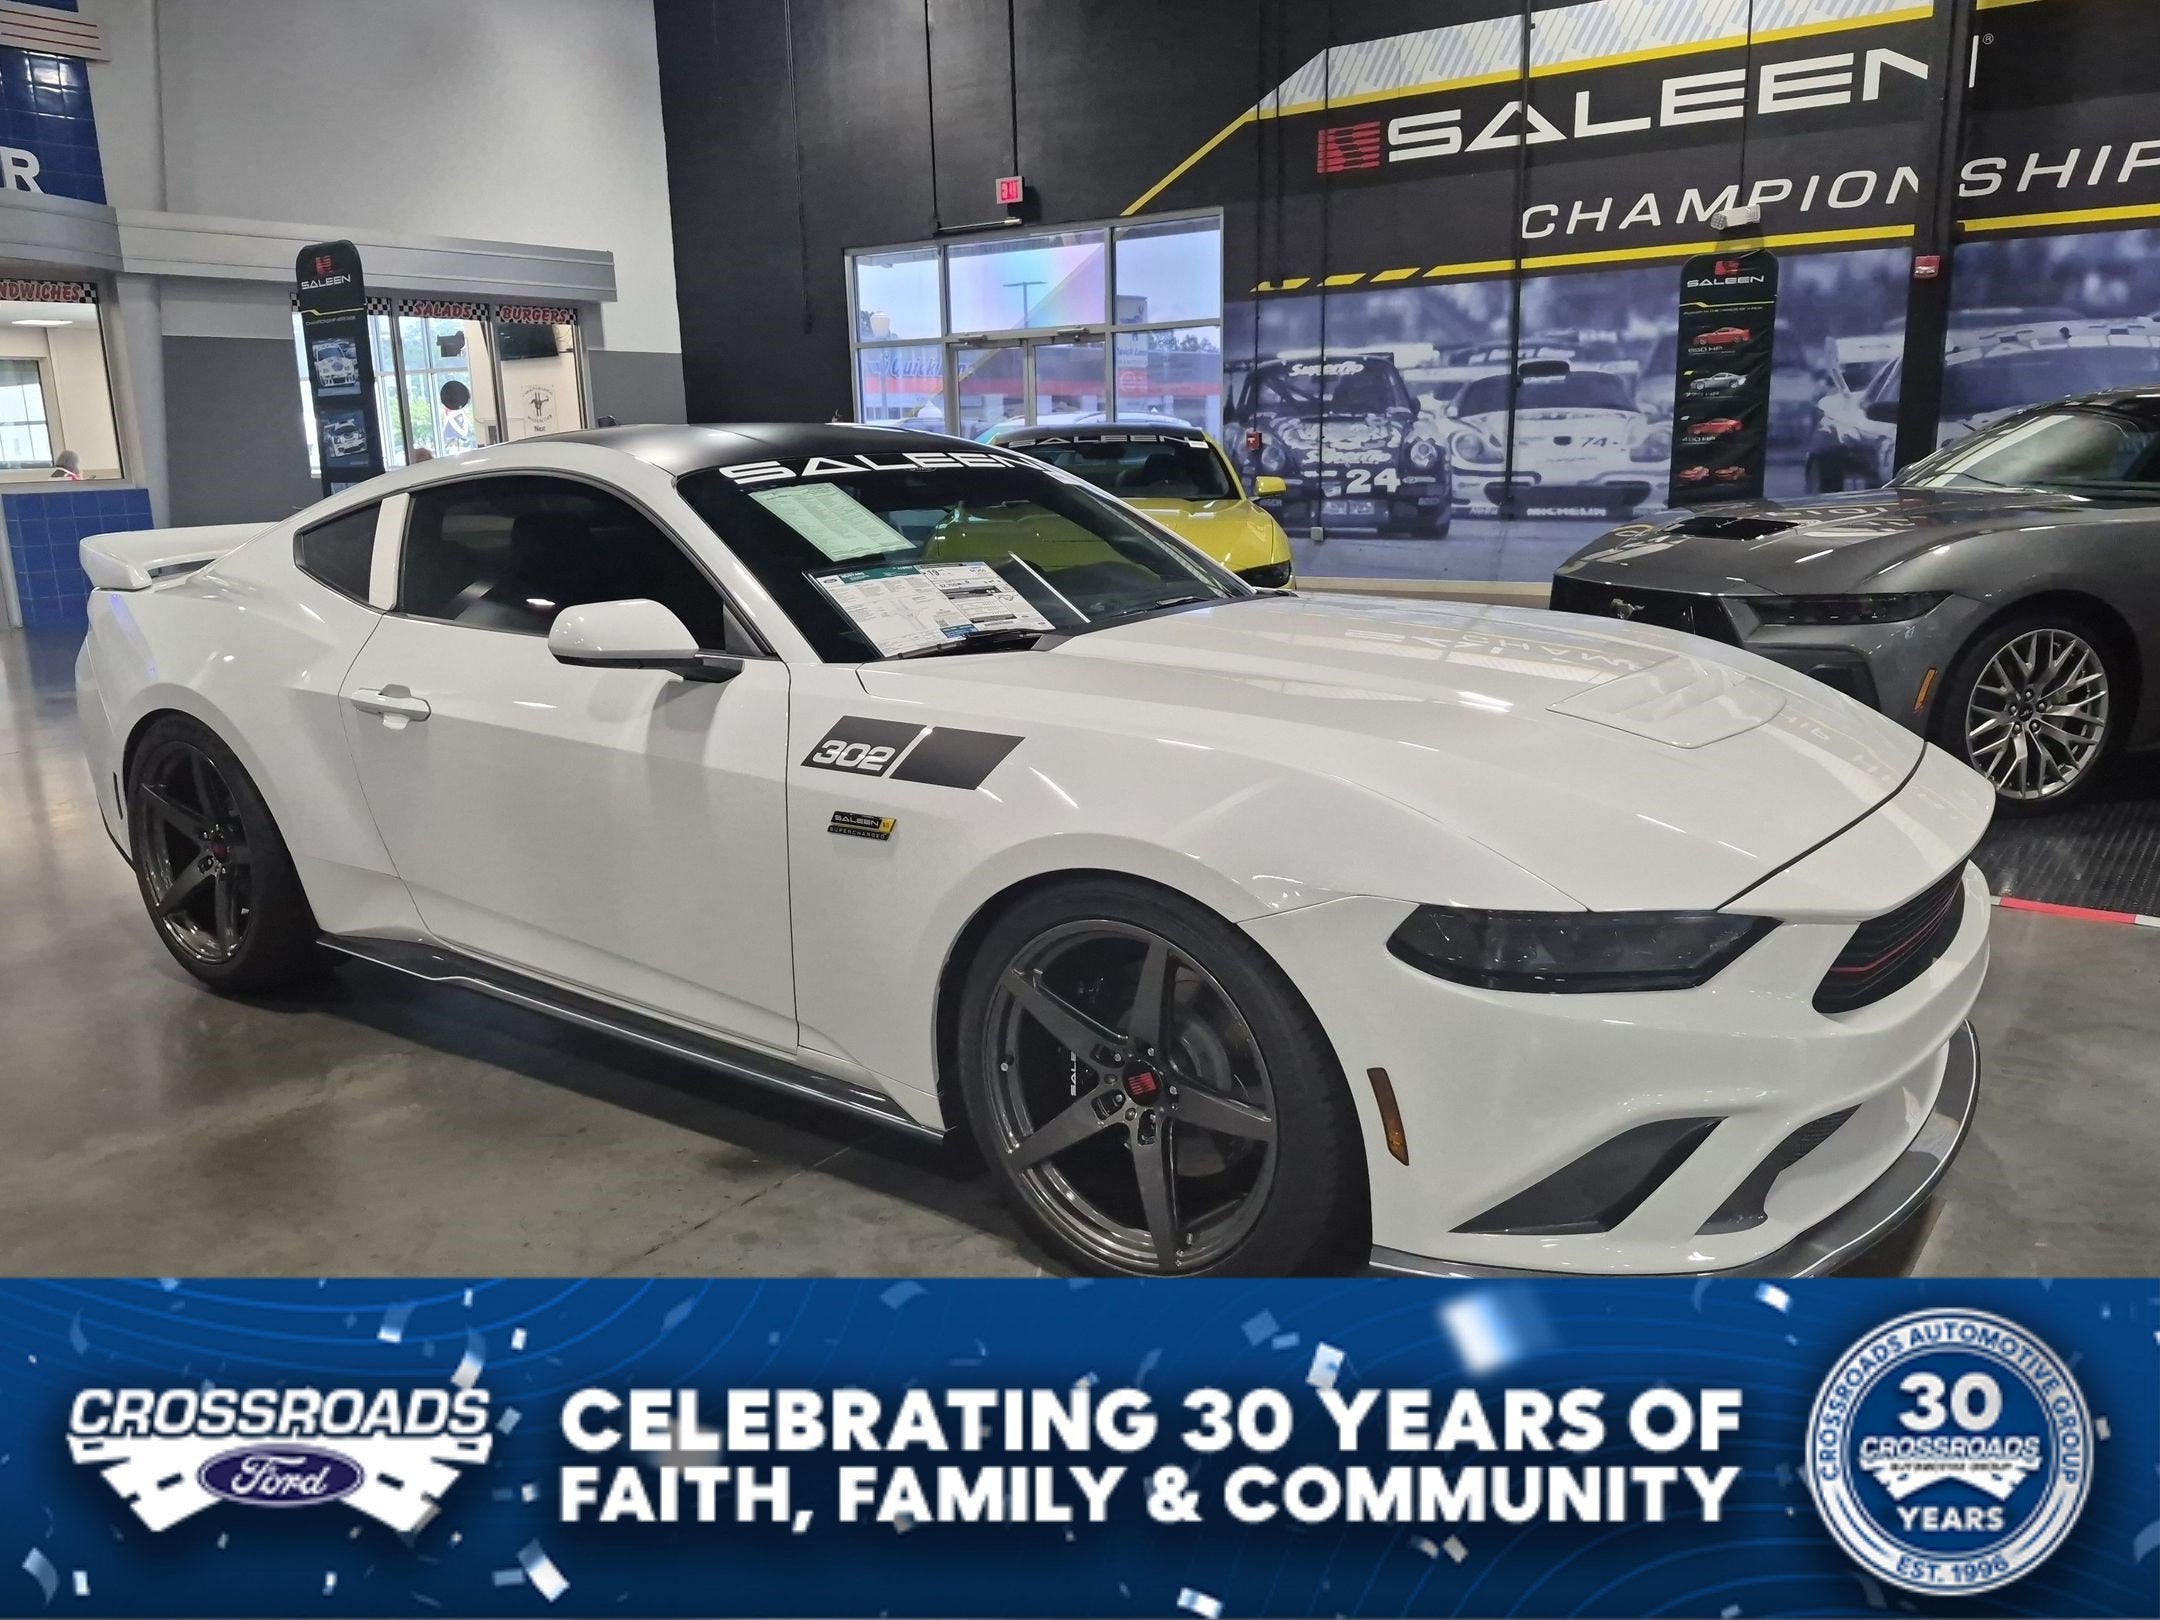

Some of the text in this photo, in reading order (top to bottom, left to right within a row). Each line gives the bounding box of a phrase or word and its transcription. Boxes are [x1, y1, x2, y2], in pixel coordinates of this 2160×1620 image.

[1387, 36, 1980, 163] SALEEN
[301, 274, 351, 290] SALEEN
[1686, 275, 1765, 288] SALEEN
[412, 301, 474, 320] SALADS
[501, 305, 570, 324] BURGERS
[1008, 434, 1190, 449] SALEEN
[719, 452, 1053, 485] SALEEN
[1346, 467, 1401, 494] 24
[812, 739, 896, 772] 302
[834, 814, 879, 826] SALEEN
